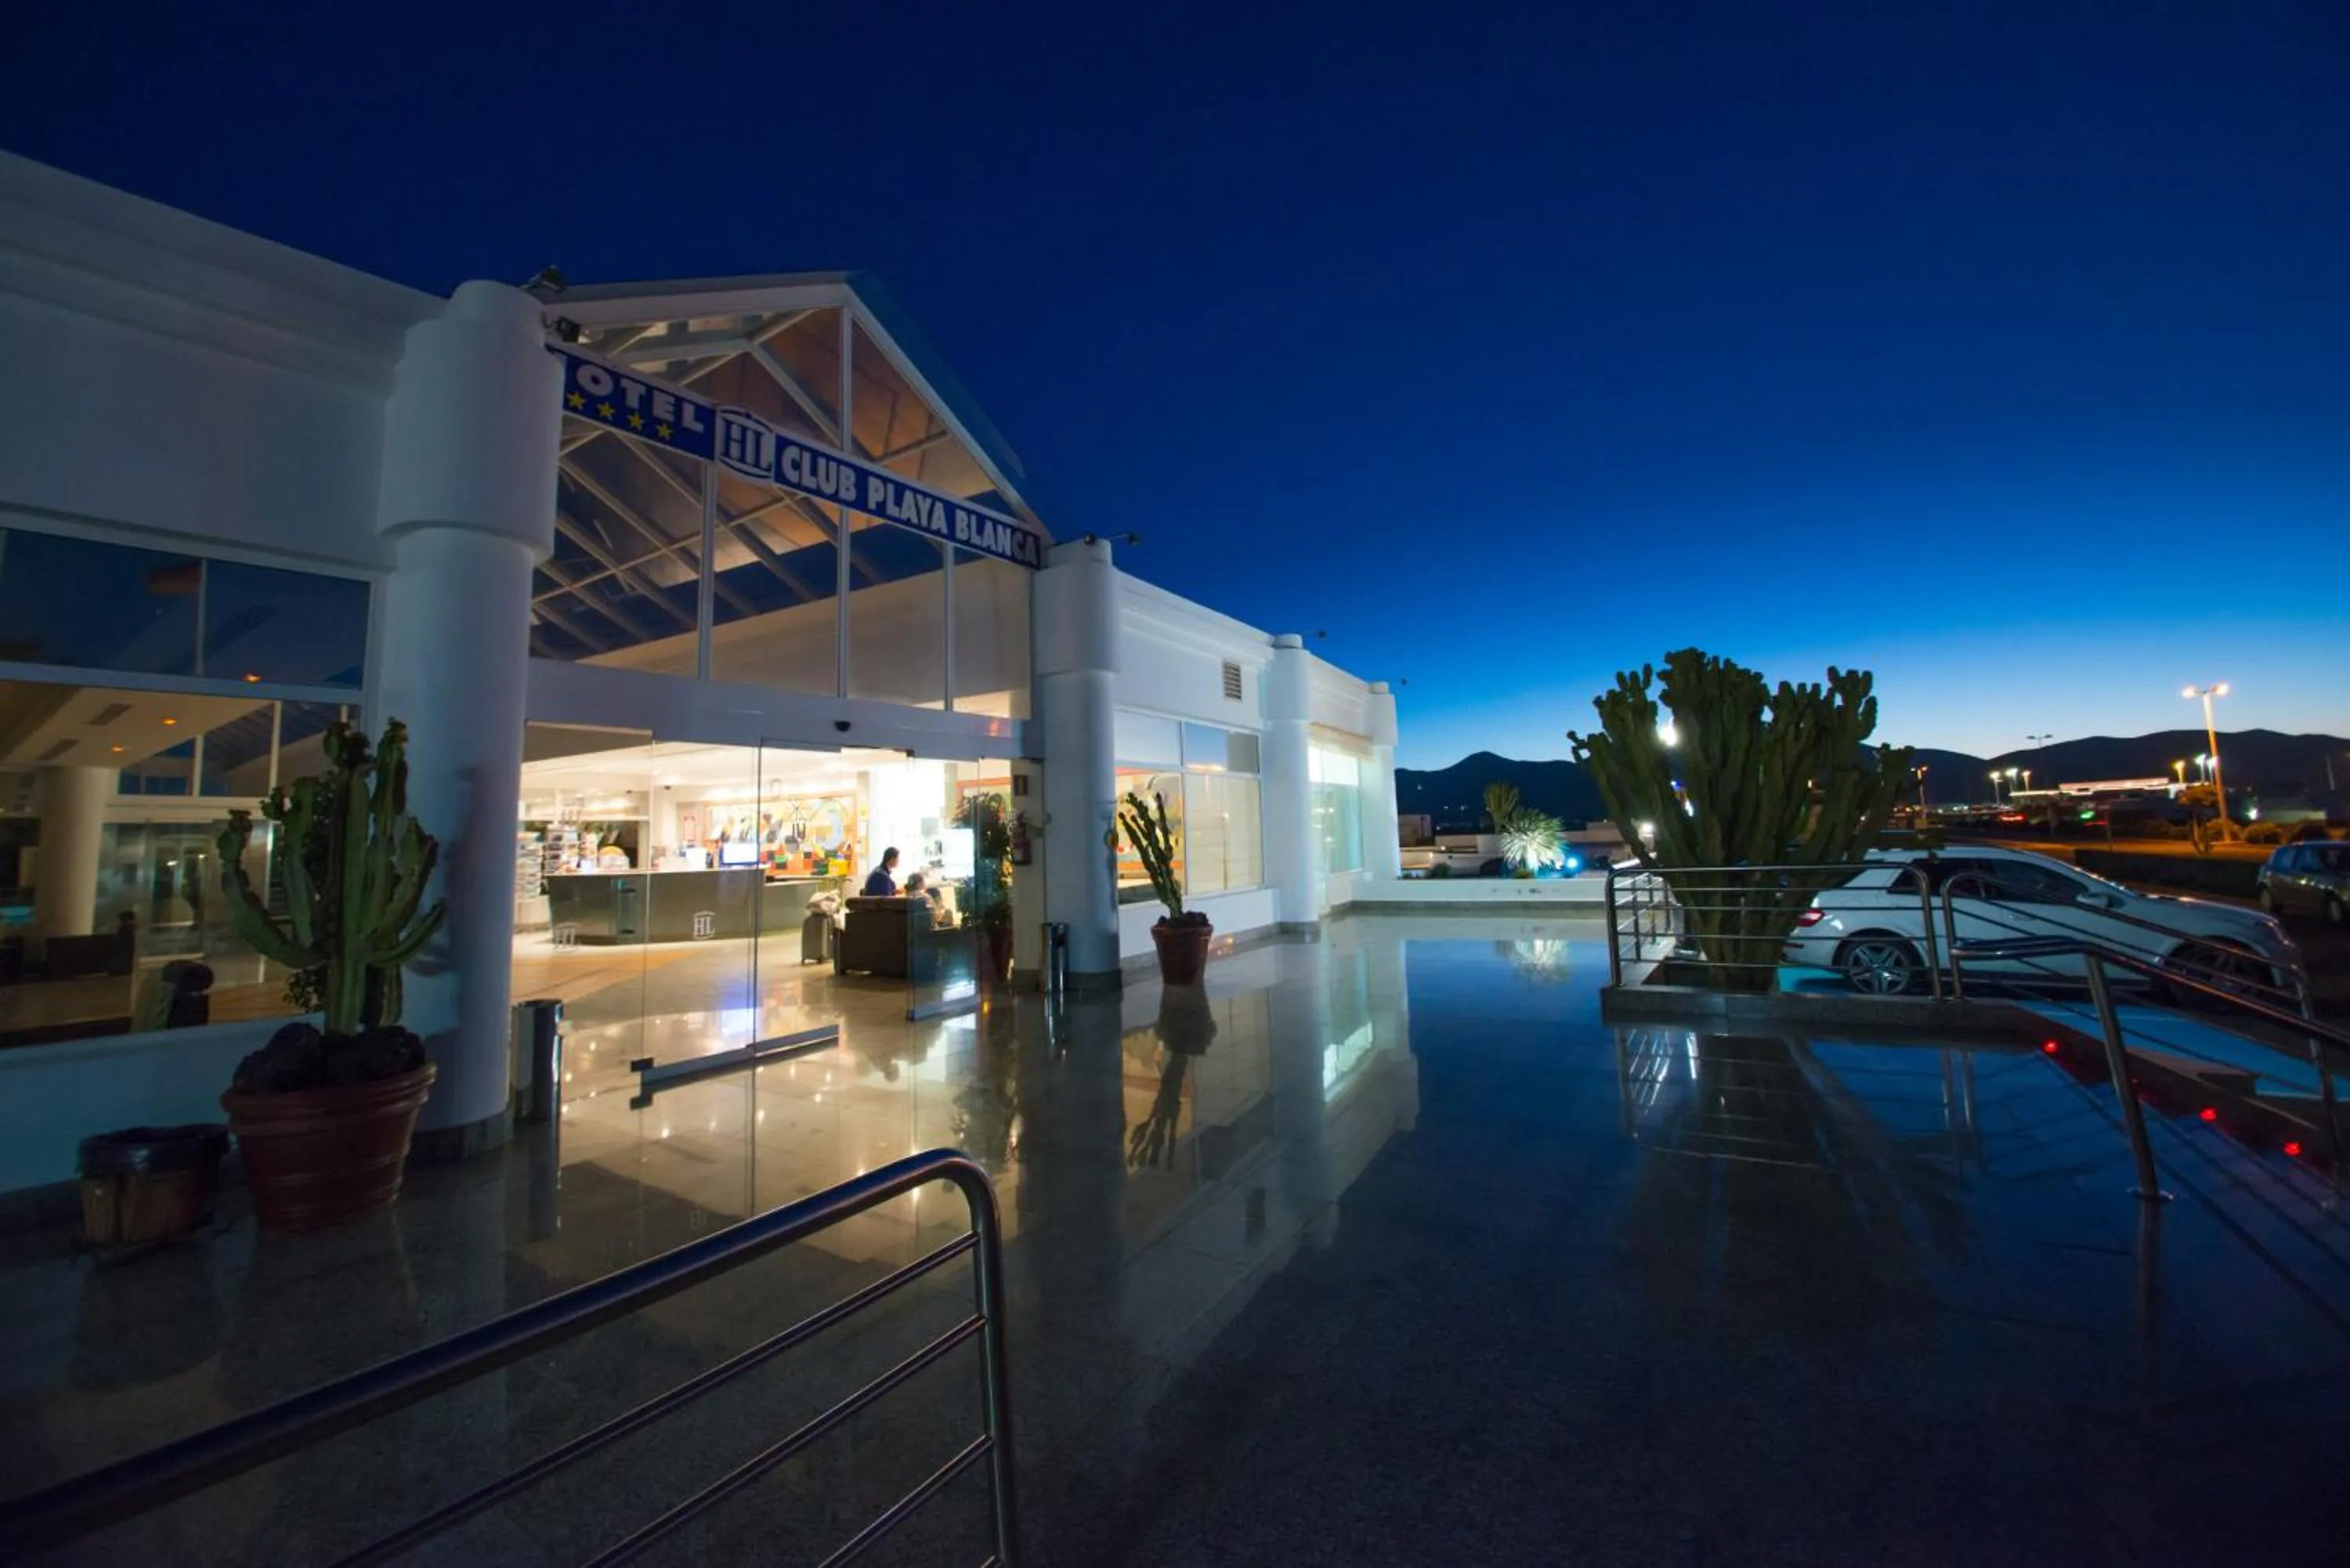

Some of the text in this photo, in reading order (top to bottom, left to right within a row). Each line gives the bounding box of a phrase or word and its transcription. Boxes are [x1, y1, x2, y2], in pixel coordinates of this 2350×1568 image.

[576, 363, 705, 434] OTEL
[781, 444, 857, 502] CLUB
[867, 475, 949, 536] PLAYA
[954, 508, 1039, 565] BLANCA
